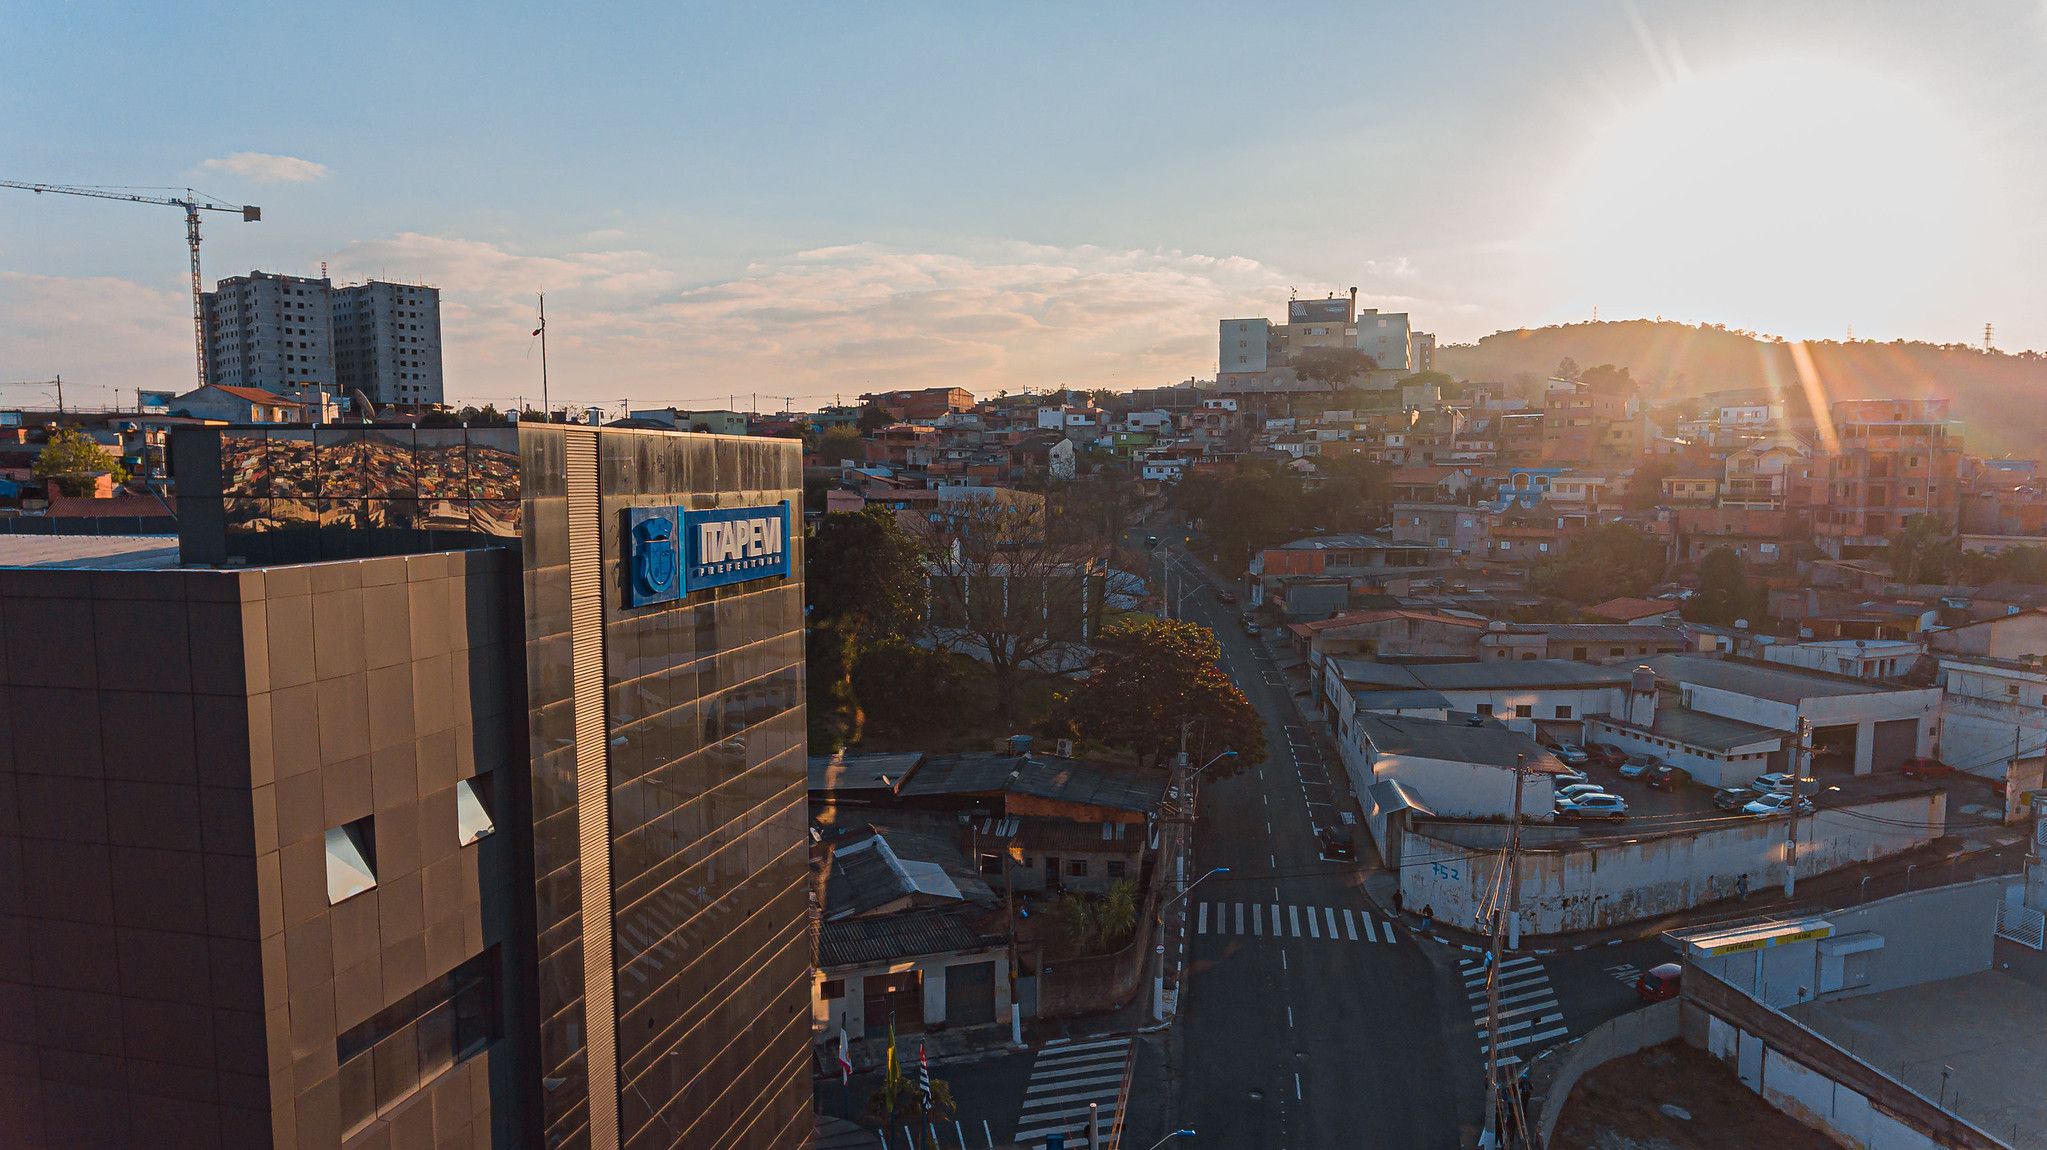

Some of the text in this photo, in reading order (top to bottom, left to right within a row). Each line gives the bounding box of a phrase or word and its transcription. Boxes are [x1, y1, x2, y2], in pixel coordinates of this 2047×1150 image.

[700, 517, 781, 564] ITAPEVI
[699, 556, 781, 577] PREFEITURA
[1431, 861, 1460, 880] 752
